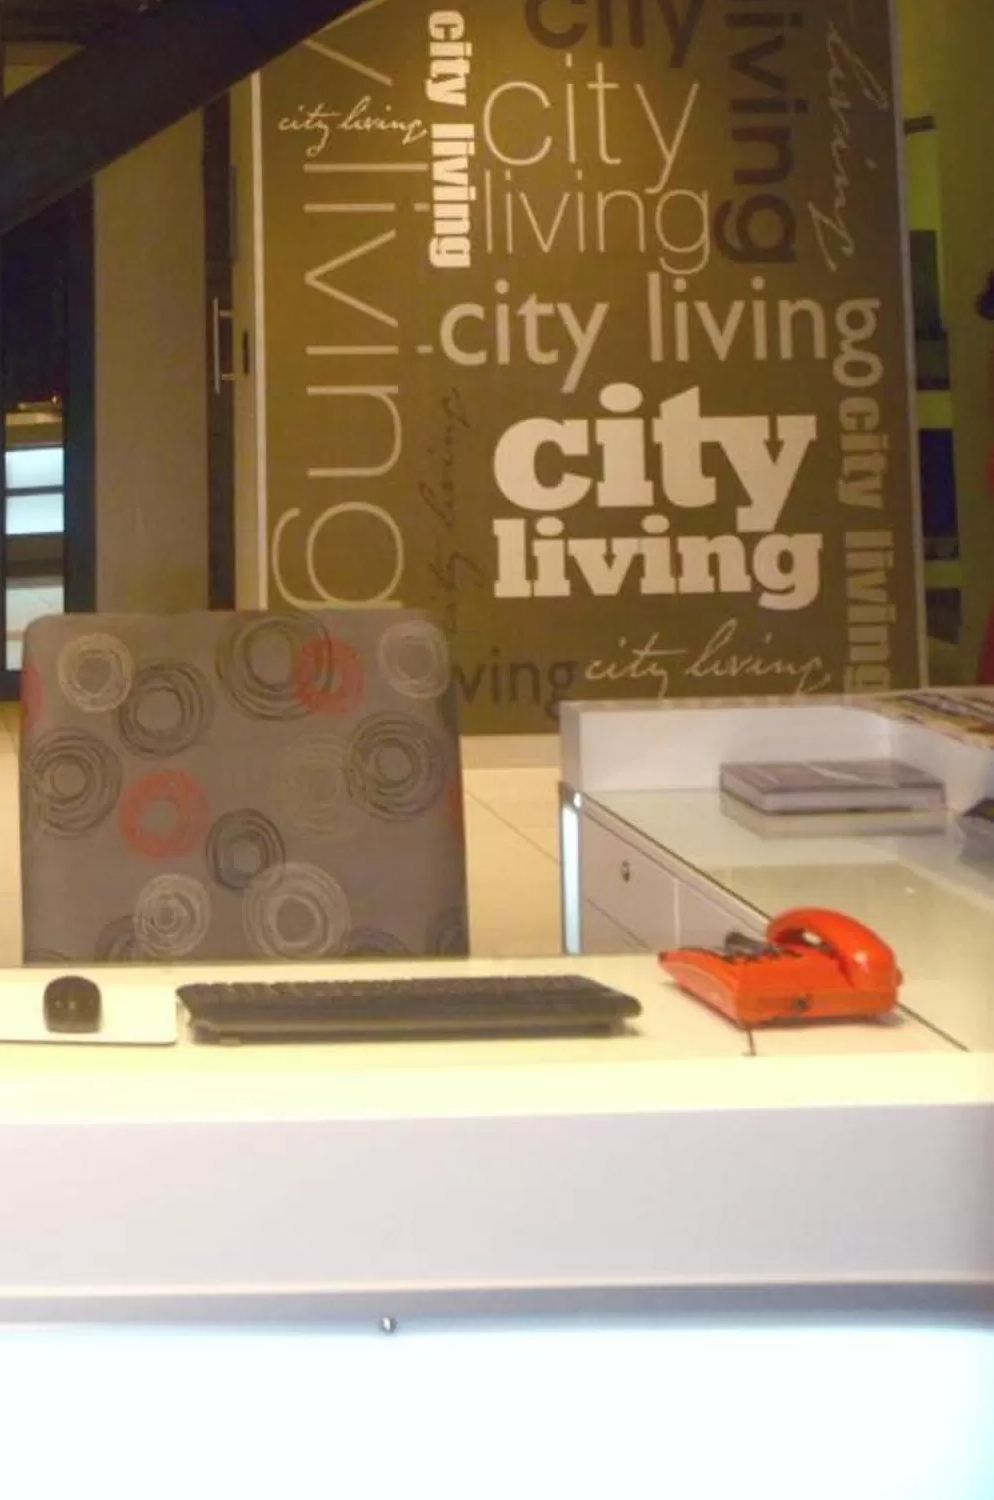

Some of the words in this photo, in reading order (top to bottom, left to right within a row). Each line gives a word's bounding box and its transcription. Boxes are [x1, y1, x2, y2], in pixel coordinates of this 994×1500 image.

[424, 9, 473, 107] city
[483, 52, 700, 195] city
[428, 123, 477, 270] living
[484, 167, 712, 275] living
[270, 161, 434, 611] living
[438, 277, 609, 395] city
[646, 271, 883, 388] living
[492, 381, 818, 532] city
[837, 397, 890, 509] city
[492, 515, 823, 611] living
[452, 646, 579, 722] ving
[583, 632, 689, 697] city
[686, 617, 831, 695] living
